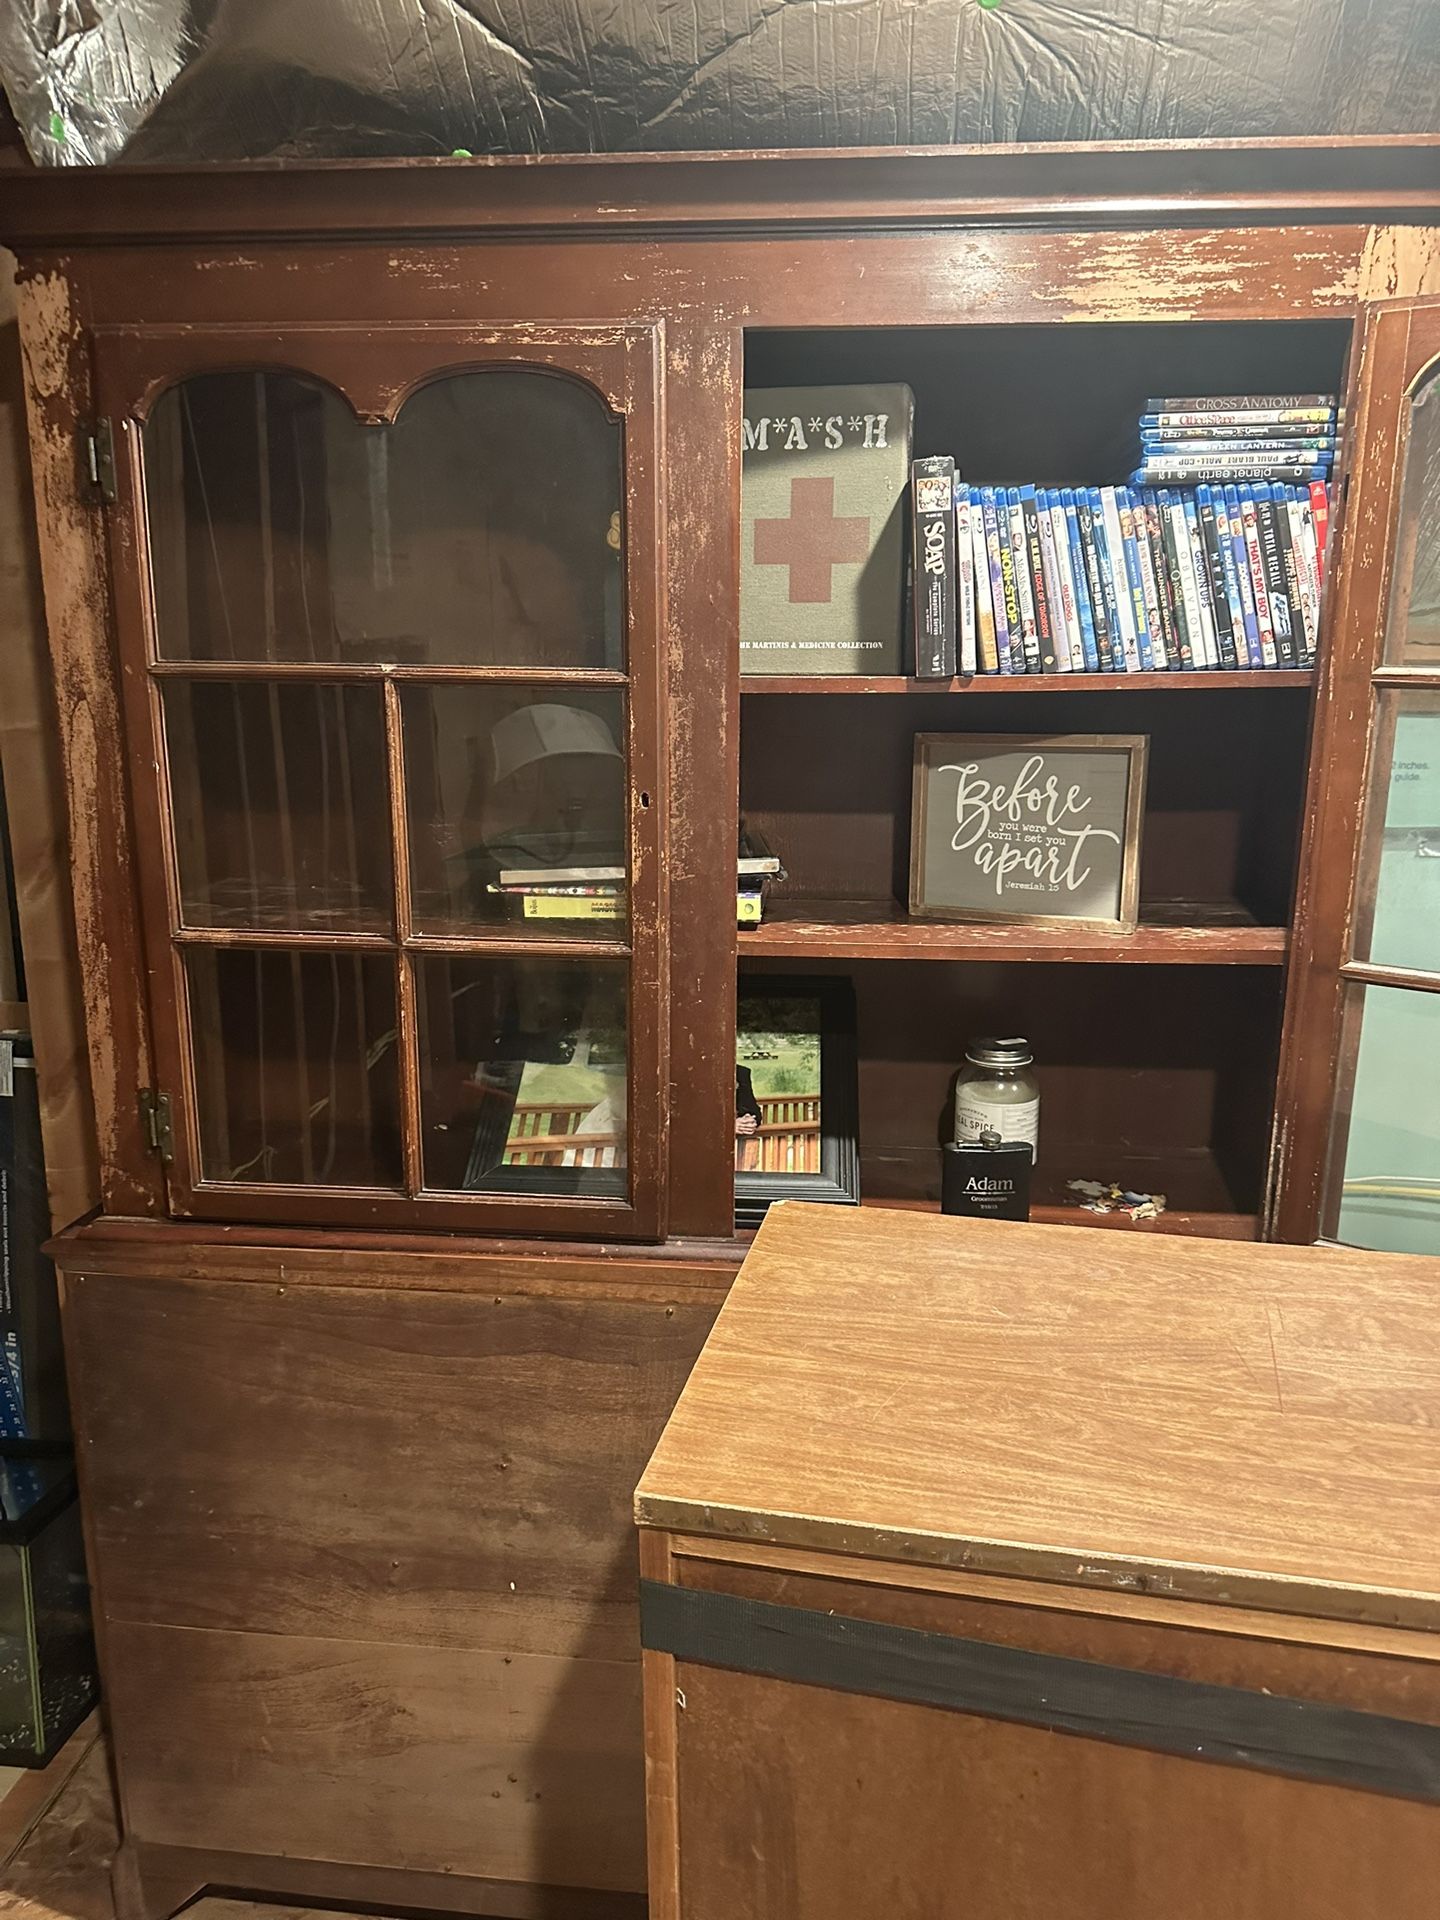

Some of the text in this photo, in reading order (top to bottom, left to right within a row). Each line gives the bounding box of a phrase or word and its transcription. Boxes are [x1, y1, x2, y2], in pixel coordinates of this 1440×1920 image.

[1195, 397, 1301, 410] GROSS ANATOMY
[1240, 442, 1285, 450] LANTERN
[1178, 458, 1195, 466] COP
[1258, 455, 1279, 463] PAUL
[1198, 466, 1272, 479] planet earth
[923, 521, 946, 575] SOAP
[1263, 528, 1276, 555] TOTAL
[1223, 550, 1235, 569] soul
[1194, 551, 1210, 609] GROWN UPS
[1211, 552, 1225, 600] HEAT
[1249, 539, 1269, 619] THAT'S MY BOY
[1268, 556, 1281, 587] RECALL
[1001, 548, 1018, 624] NON-STOP
[1153, 549, 1172, 641] THE HUNGER GAMES
[1180, 551, 1200, 638] OBLIVION
[1034, 574, 1050, 639] EDGE OF TOMORROW
[1065, 601, 1073, 622] DOGS
[739, 641, 884, 649] HE MARTINIS & MEDICINE COLLECTION
[938, 755, 1092, 851] Before
[999, 821, 1048, 834] you were
[987, 829, 1066, 848] born I set you
[974, 824, 1120, 895] apart
[1004, 880, 1045, 892] Jeremiah
[969, 1120, 995, 1132] SPICE
[965, 1176, 1013, 1191] Adam
[4, 1331, 17, 1347] in
